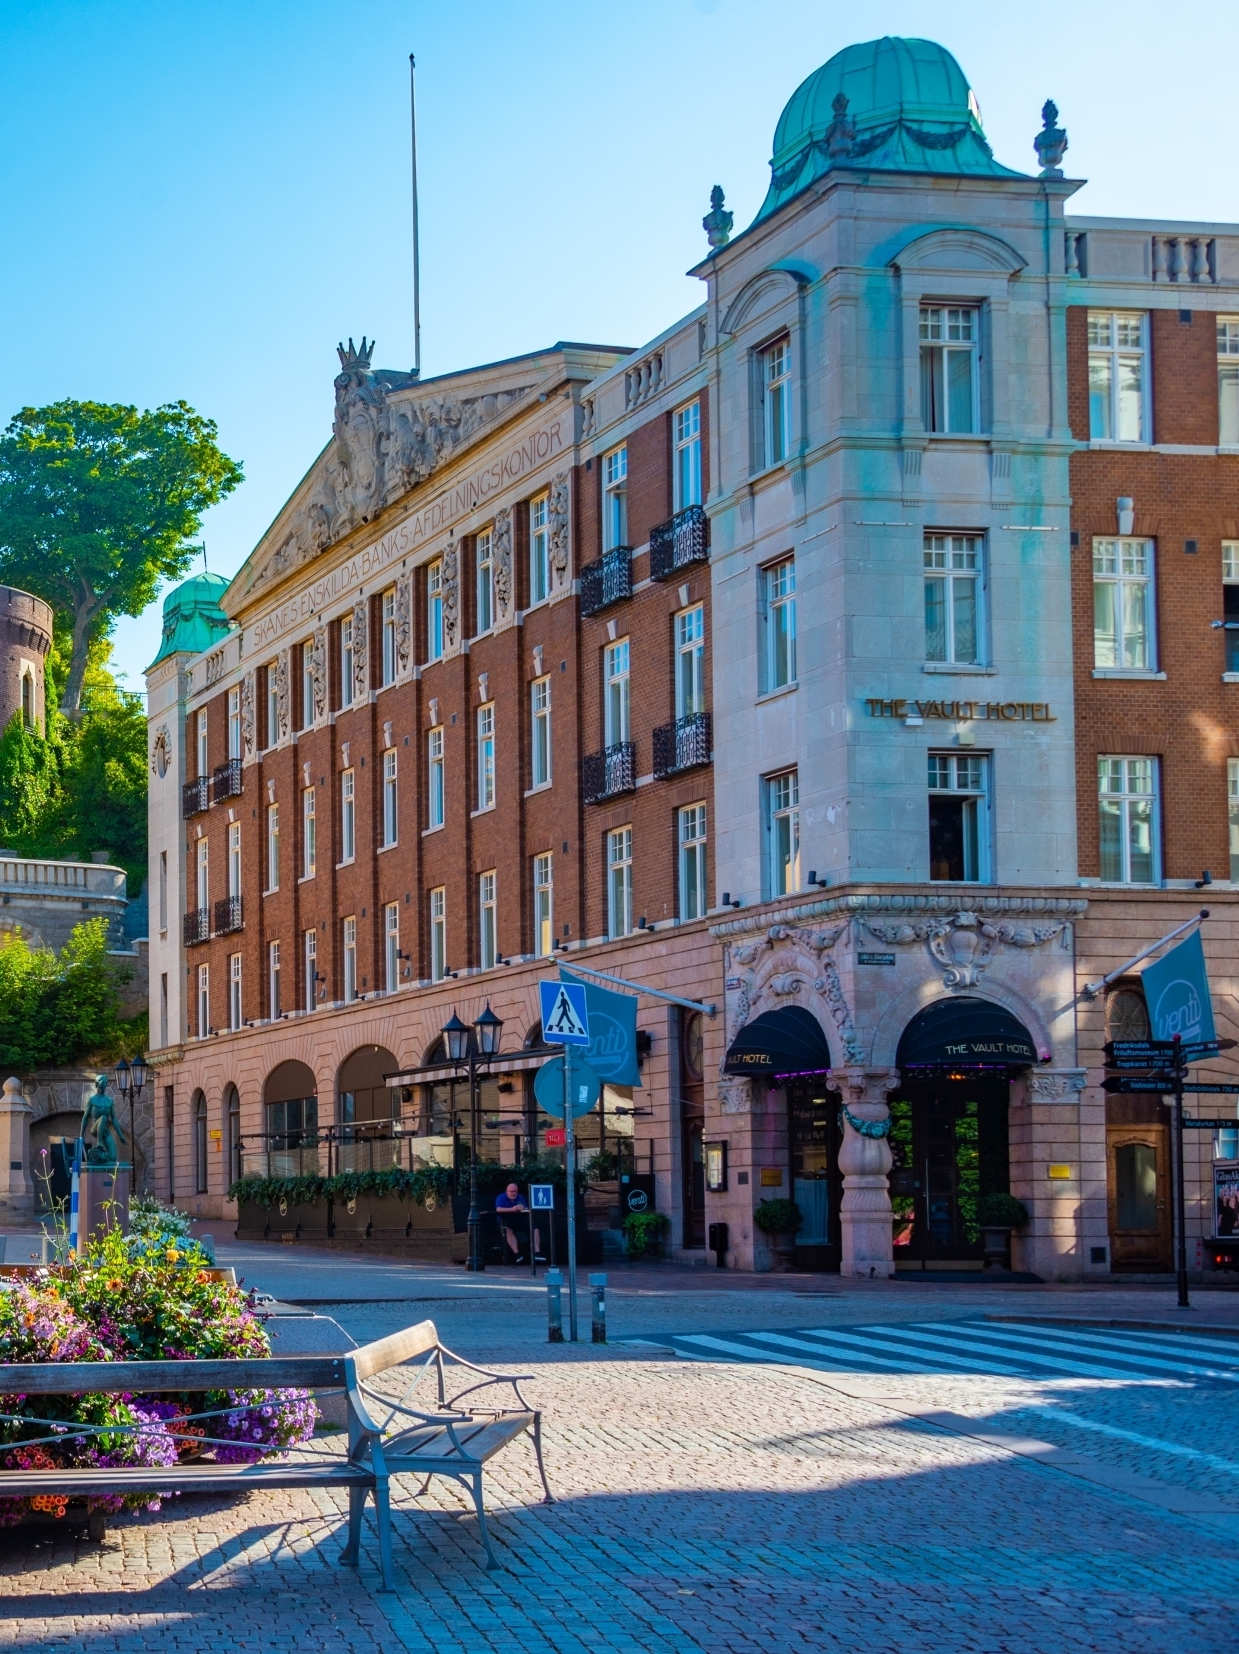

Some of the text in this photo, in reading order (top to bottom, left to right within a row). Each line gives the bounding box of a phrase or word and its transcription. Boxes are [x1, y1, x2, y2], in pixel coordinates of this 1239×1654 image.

[254, 422, 562, 646] SKÅNES ENSKILDA BANKS AFDELNINGSKONTOR
[865, 698, 1057, 721] THE VAULT HOTEL
[1158, 992, 1201, 1040] venti
[742, 1054, 772, 1064] HOTEL
[945, 1043, 1031, 1056] THE VAULT HOTEL
